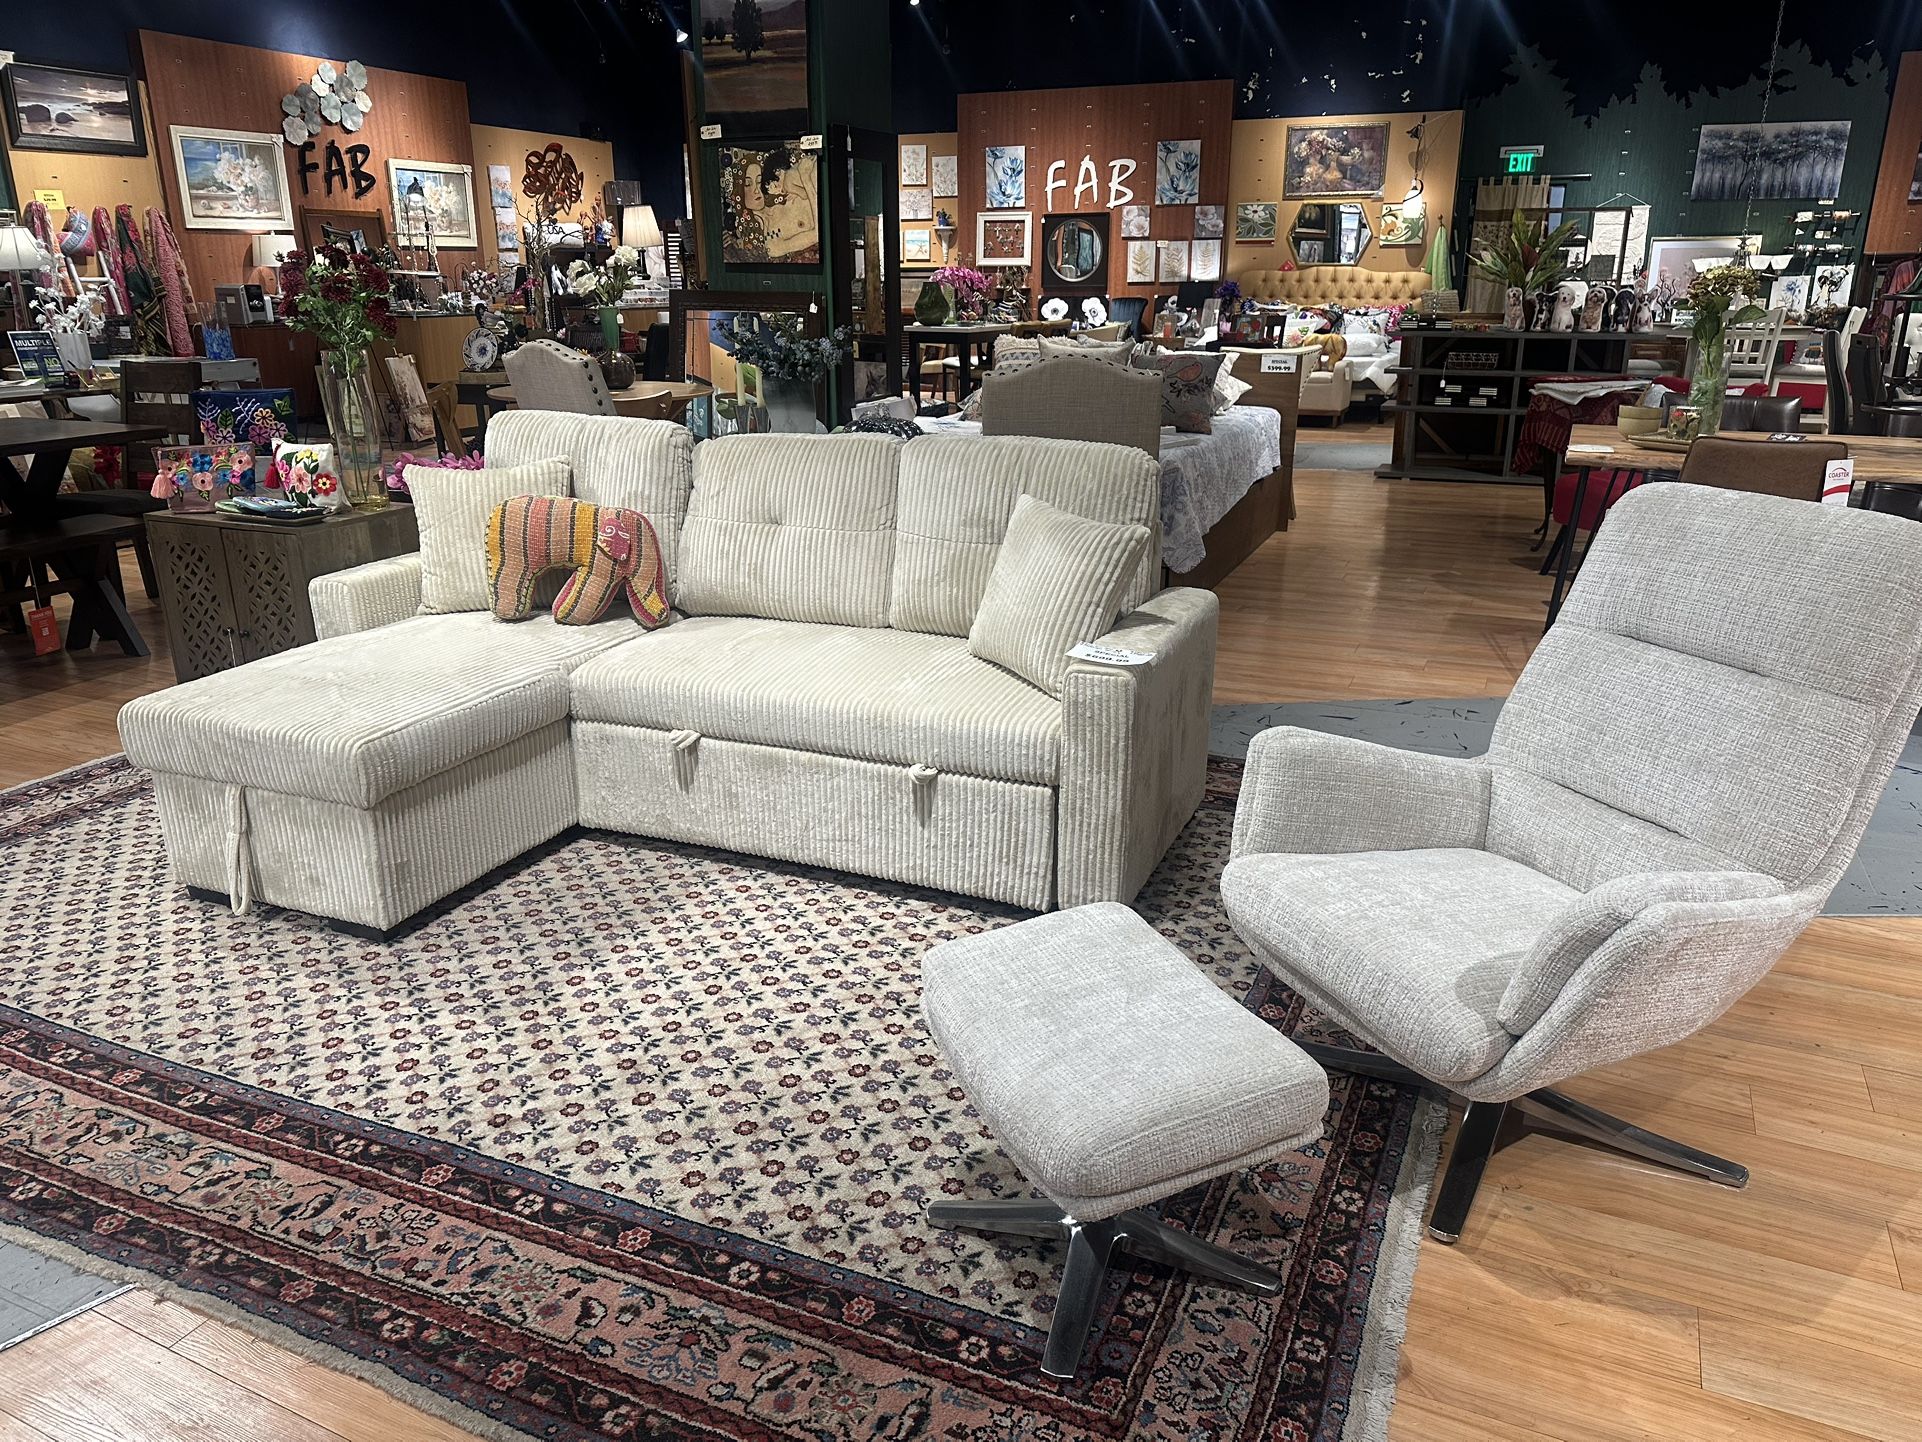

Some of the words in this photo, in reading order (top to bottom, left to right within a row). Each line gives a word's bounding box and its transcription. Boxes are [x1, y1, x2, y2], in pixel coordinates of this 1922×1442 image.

[297, 138, 377, 200] FAB
[1508, 153, 1534, 173] EXIT
[1044, 154, 1137, 213] FAB
[547, 224, 566, 235] USA
[15, 339, 52, 347] MULTIPLE
[1094, 650, 1130, 659] SPECIAL
